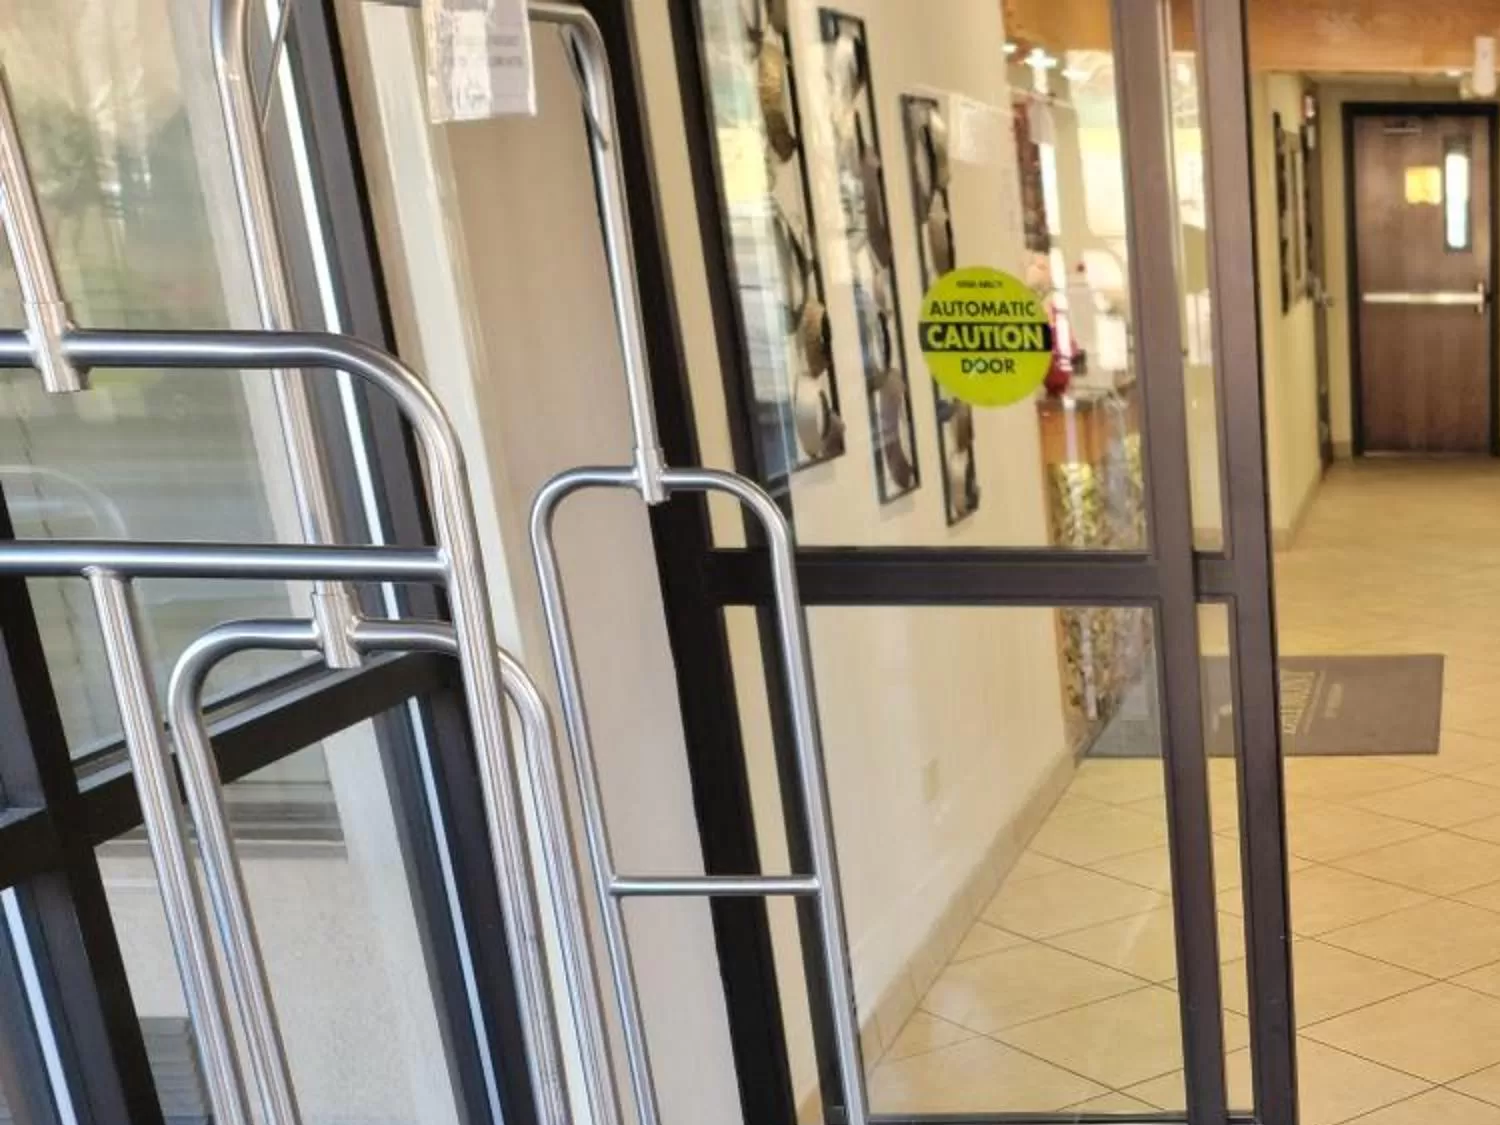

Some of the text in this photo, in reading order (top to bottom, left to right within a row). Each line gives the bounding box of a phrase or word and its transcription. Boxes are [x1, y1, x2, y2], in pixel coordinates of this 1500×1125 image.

[929, 300, 1036, 318] AUTOMATIC
[926, 324, 1044, 350] CAUTION
[960, 357, 1016, 375] DOOR
